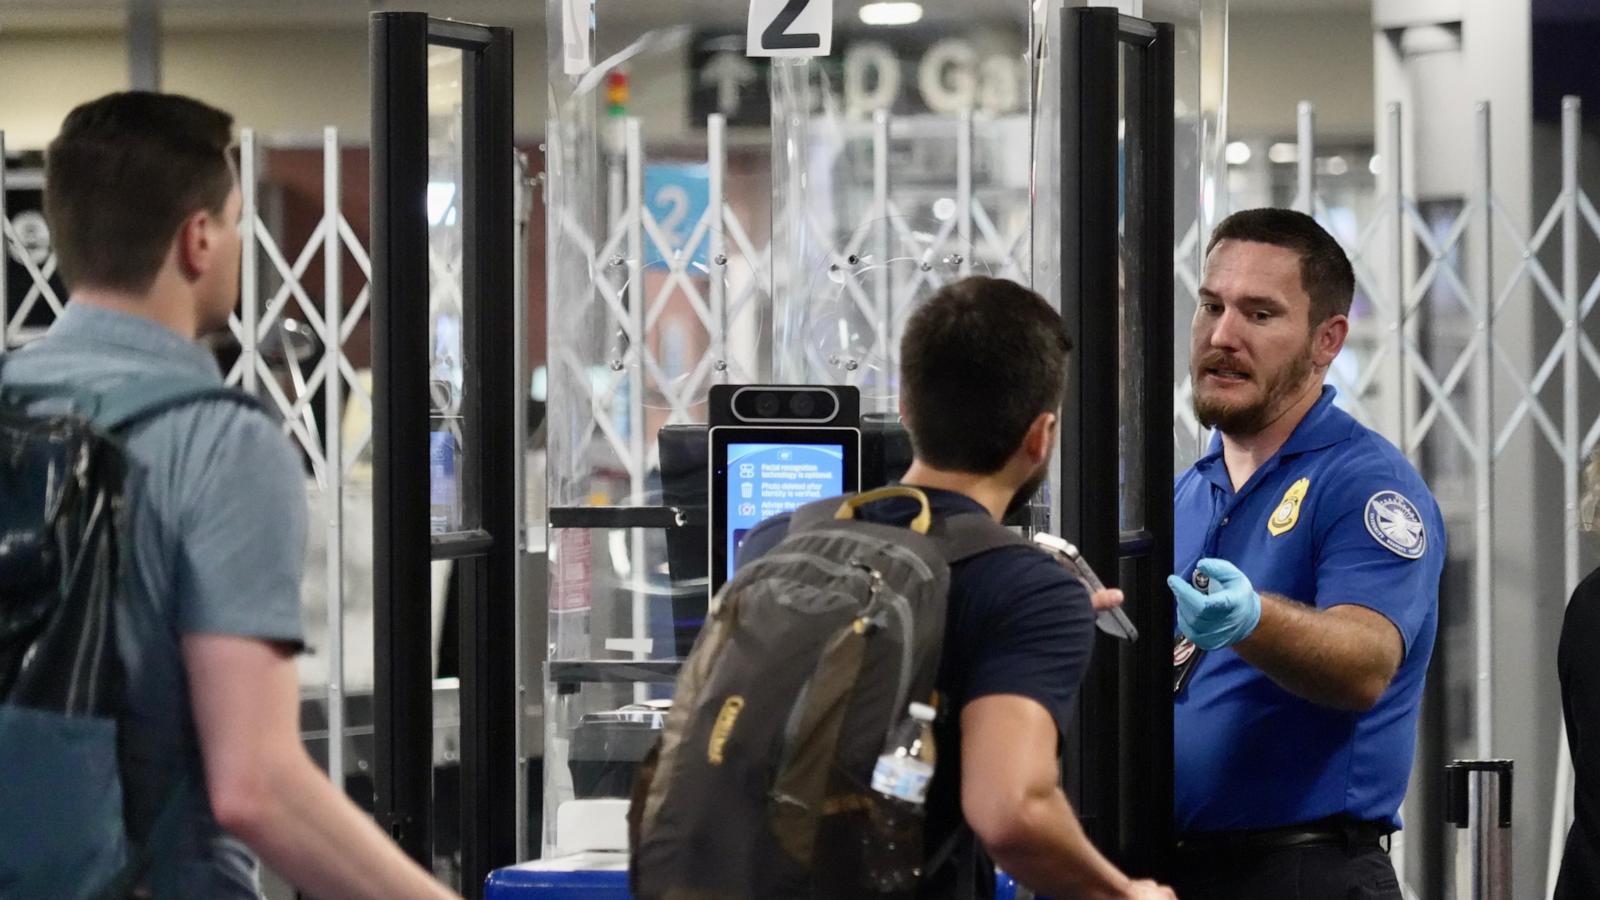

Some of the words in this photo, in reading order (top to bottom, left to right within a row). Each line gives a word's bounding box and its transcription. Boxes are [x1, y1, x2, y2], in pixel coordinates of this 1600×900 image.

[761, 0, 821, 49] 2
[917, 38, 1022, 117] Ga
[655, 185, 690, 247] 2
